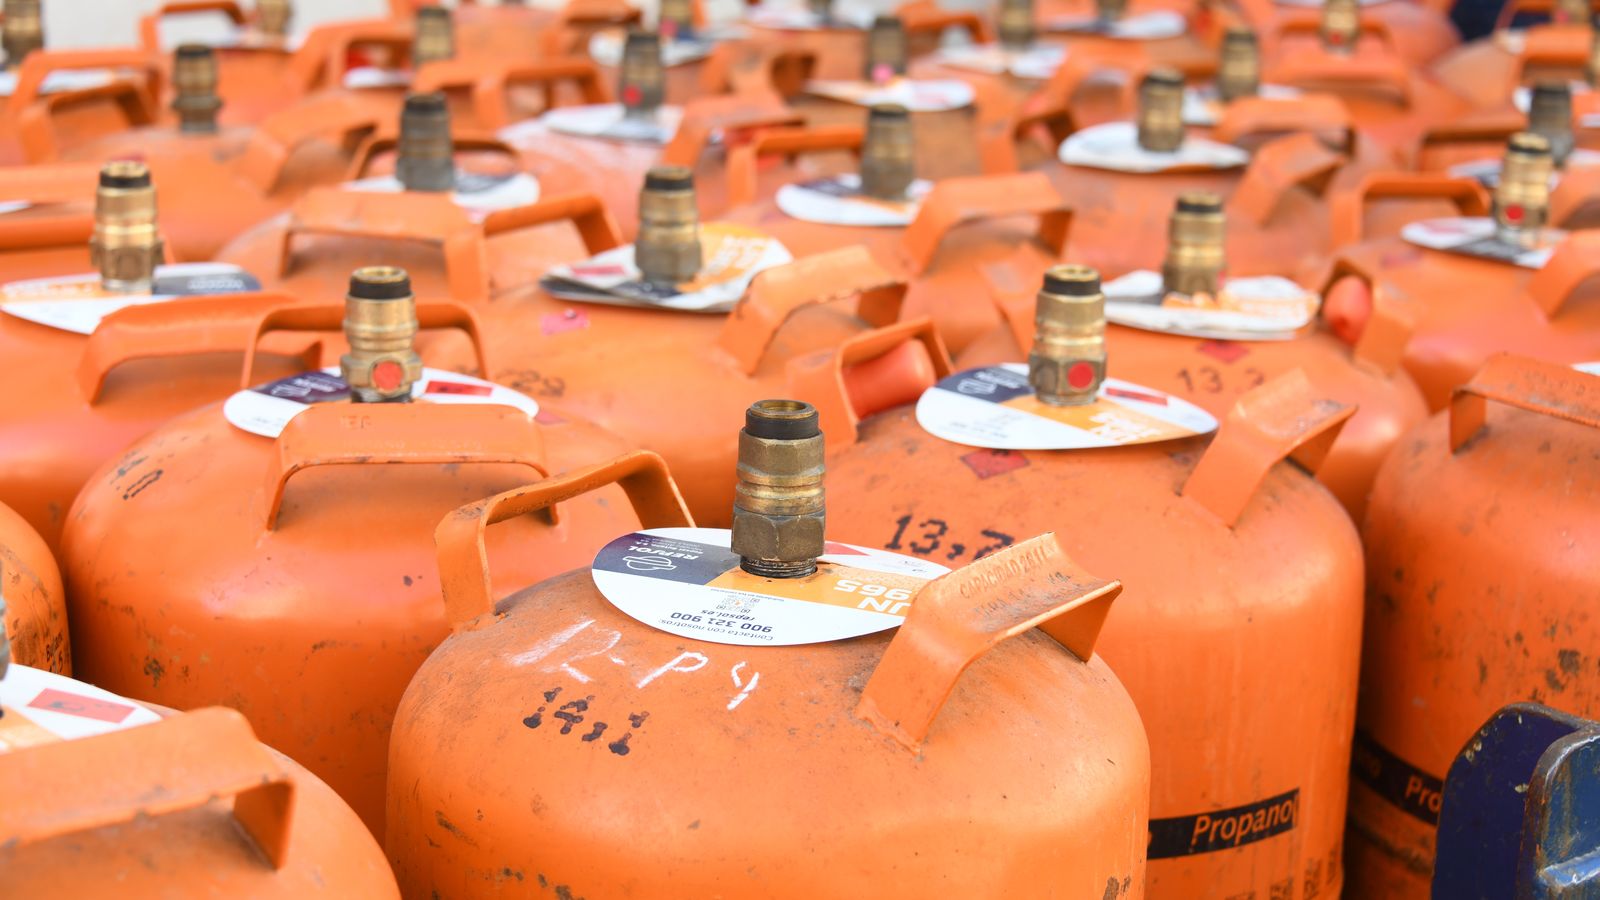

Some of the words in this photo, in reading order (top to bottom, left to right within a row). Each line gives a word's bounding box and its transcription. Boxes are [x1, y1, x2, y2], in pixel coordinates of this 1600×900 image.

[628, 545, 699, 560] REPSOL
[670, 611, 703, 623] 900
[700, 609, 756, 621] repsol.es
[657, 618, 705, 631] nosotros:
[707, 617, 737, 628] 321
[740, 622, 773, 633] 900
[727, 629, 774, 641] Contacta
[1190, 799, 1293, 849] Propano
